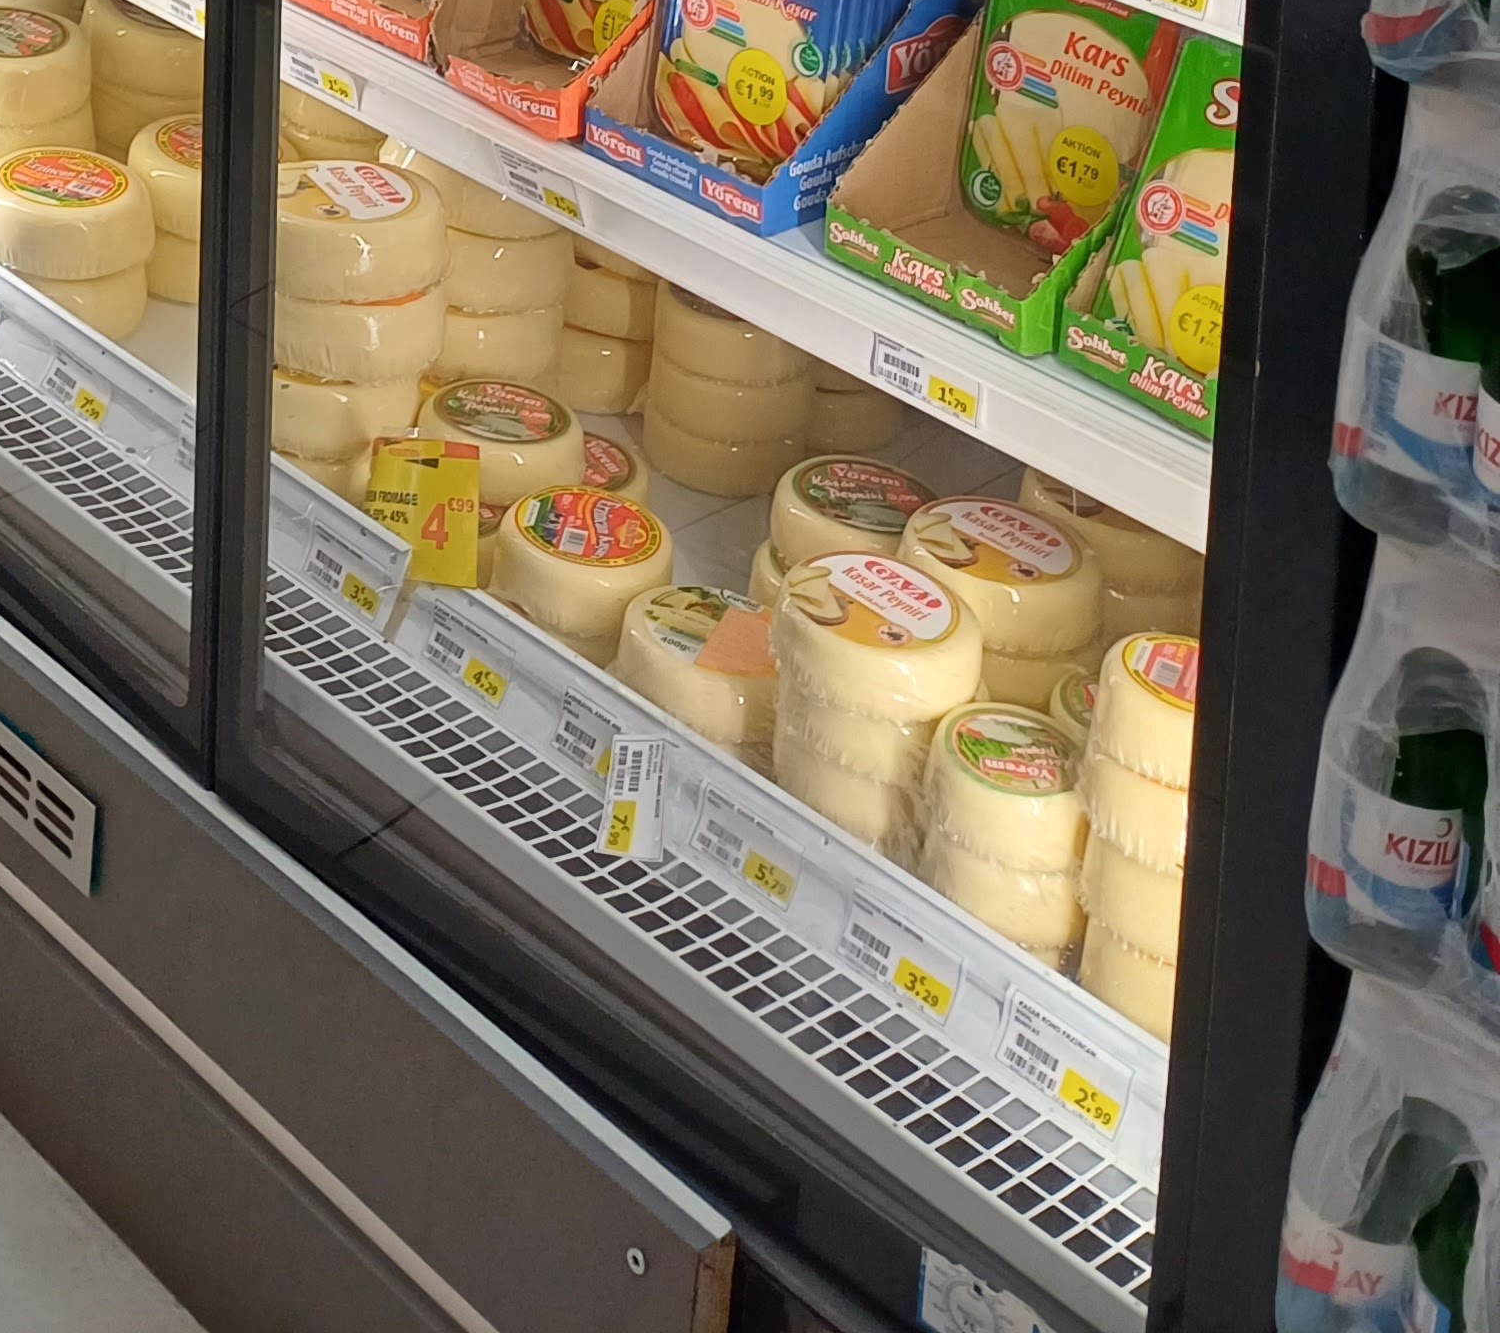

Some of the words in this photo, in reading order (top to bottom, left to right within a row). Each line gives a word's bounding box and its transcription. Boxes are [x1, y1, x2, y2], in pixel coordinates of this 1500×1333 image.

[373, 13, 420, 45] Yörem
[1063, 31, 1130, 79] Kars
[739, 65, 776, 88] ACTION
[1049, 59, 1094, 98] Dilim
[502, 91, 558, 119] Yörem
[590, 124, 643, 163] Yörem
[1061, 135, 1101, 161] AKTION
[788, 158, 823, 178] Gouda
[799, 171, 832, 191] Gouda
[1055, 153, 1100, 190] €1,79
[702, 176, 760, 219] Yörem
[793, 190, 827, 212] Gouda
[828, 221, 880, 258] Sohbet
[883, 262, 912, 284] Dilim
[912, 276, 952, 302] Peynir
[892, 247, 945, 286] Kars
[959, 287, 1016, 325] Sohbet
[1066, 326, 1128, 367] Sohbet
[1128, 373, 1162, 400] Dilim
[1163, 388, 1210, 420] Peynir
[1139, 355, 1205, 401] Kars
[378, 490, 418, 506] FROMAGE
[389, 509, 409, 525] 45%
[420, 503, 449, 551] 4
[447, 497, 474, 514] €99
[878, 585, 933, 621] Peyniri
